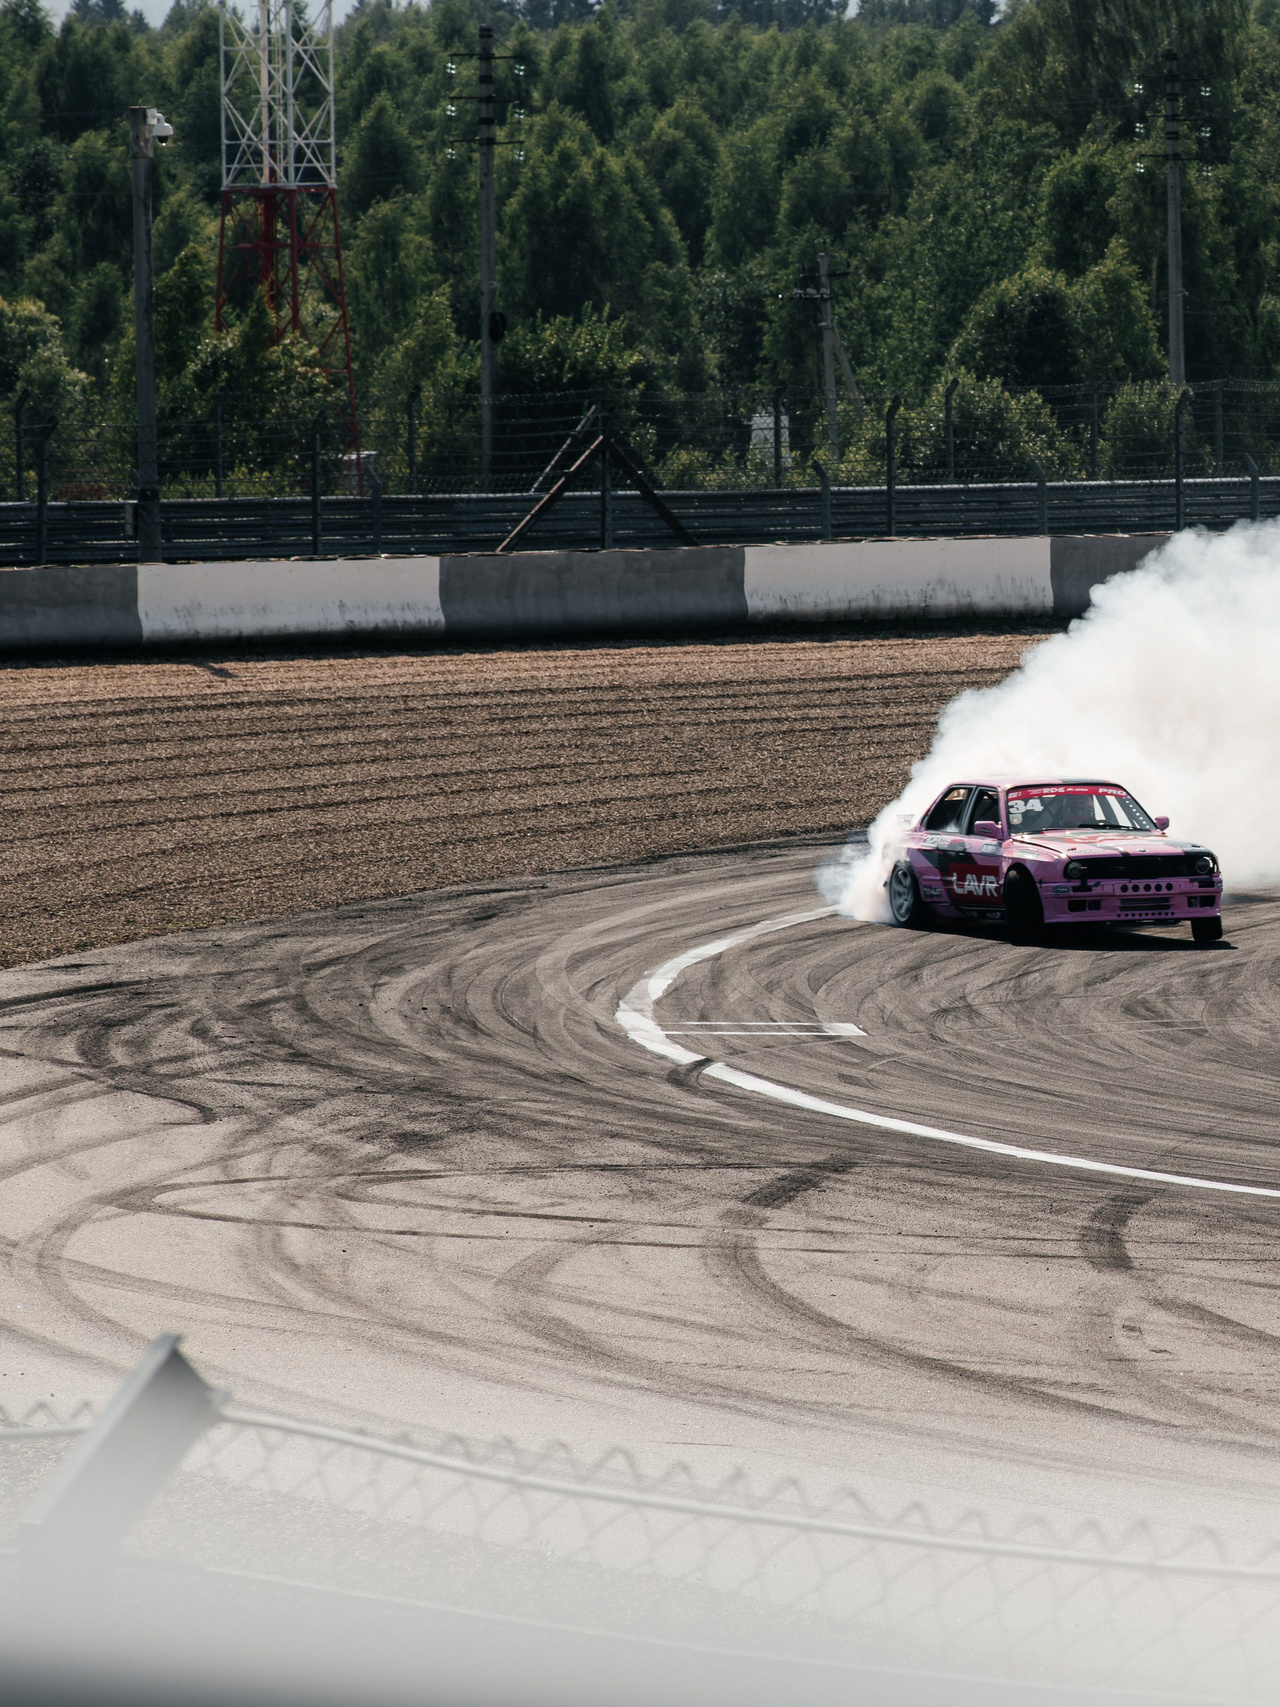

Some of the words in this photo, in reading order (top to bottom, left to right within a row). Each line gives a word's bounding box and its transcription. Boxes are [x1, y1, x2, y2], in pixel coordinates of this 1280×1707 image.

[1098, 788, 1127, 796] PRO
[1008, 800, 1043, 814] 34
[952, 872, 998, 897] LAVR
